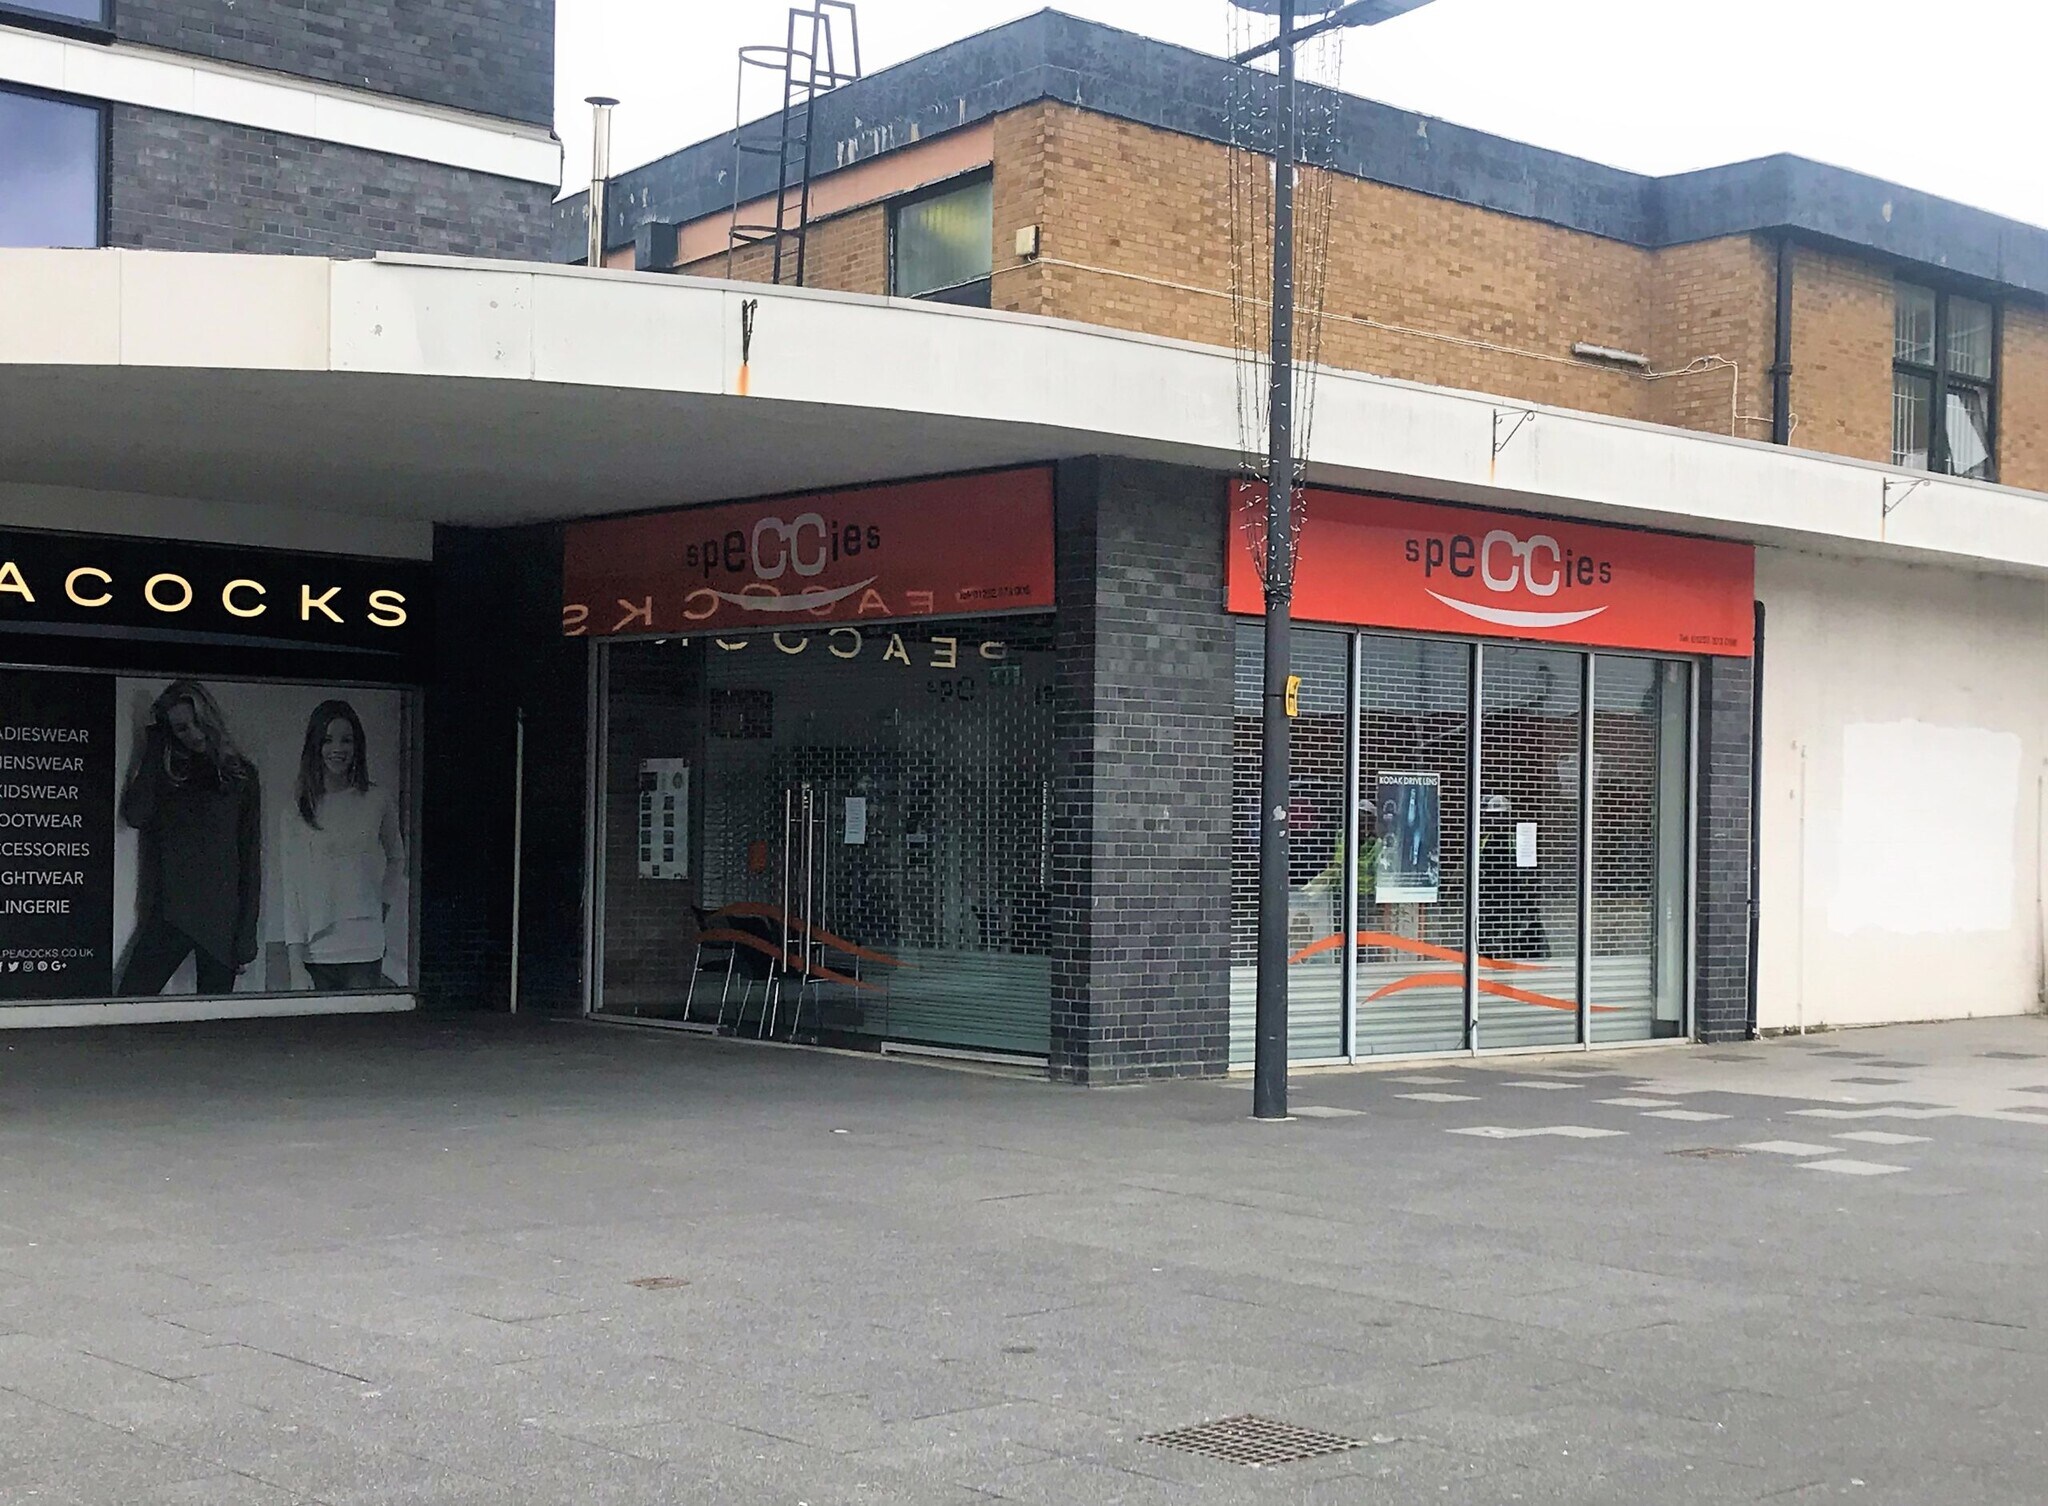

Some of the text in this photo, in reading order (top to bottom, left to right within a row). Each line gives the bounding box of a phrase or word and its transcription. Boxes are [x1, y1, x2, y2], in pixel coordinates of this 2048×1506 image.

[0, 755, 84, 771] ENSWEAR
[1379, 776, 1438, 786] KODAK DRIVE LENS
[0, 842, 90, 857] CESSORIES
